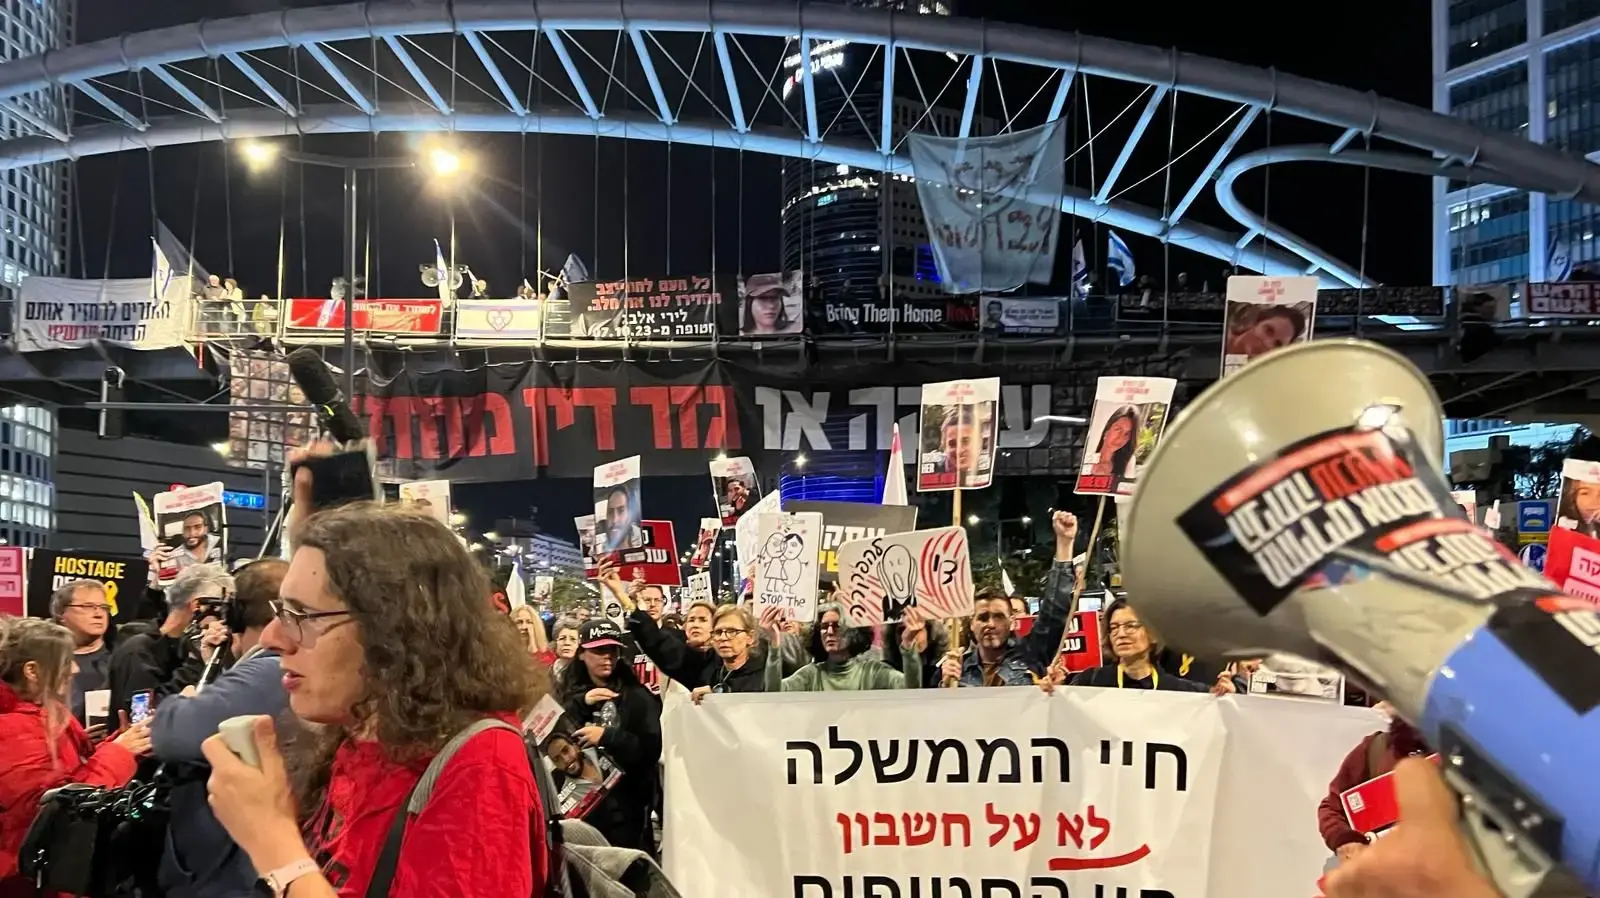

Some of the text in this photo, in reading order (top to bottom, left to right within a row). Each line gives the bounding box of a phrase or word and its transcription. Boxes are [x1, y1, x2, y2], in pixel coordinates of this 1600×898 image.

[650, 293, 670, 308] לנו
[691, 275, 710, 290] כל
[25, 301, 64, 321] אותם
[660, 308, 688, 325] לירי
[675, 323, 716, 335] חטופה
[825, 304, 860, 325] Bring
[863, 303, 900, 323] Them
[903, 303, 943, 323] Home
[522, 387, 616, 467] דין
[630, 386, 742, 450] גזר
[755, 386, 833, 451] או
[848, 384, 1051, 464] עקה
[1226, 471, 1324, 554] הביתה
[1254, 496, 1364, 588] מחזירים
[1348, 477, 1440, 526] אותם
[54, 556, 127, 579] HOSTAGE
[760, 593, 806, 607] STOP The
[786, 725, 1187, 792] חיי הממשלה
[836, 802, 1112, 853] לא על חשבון
